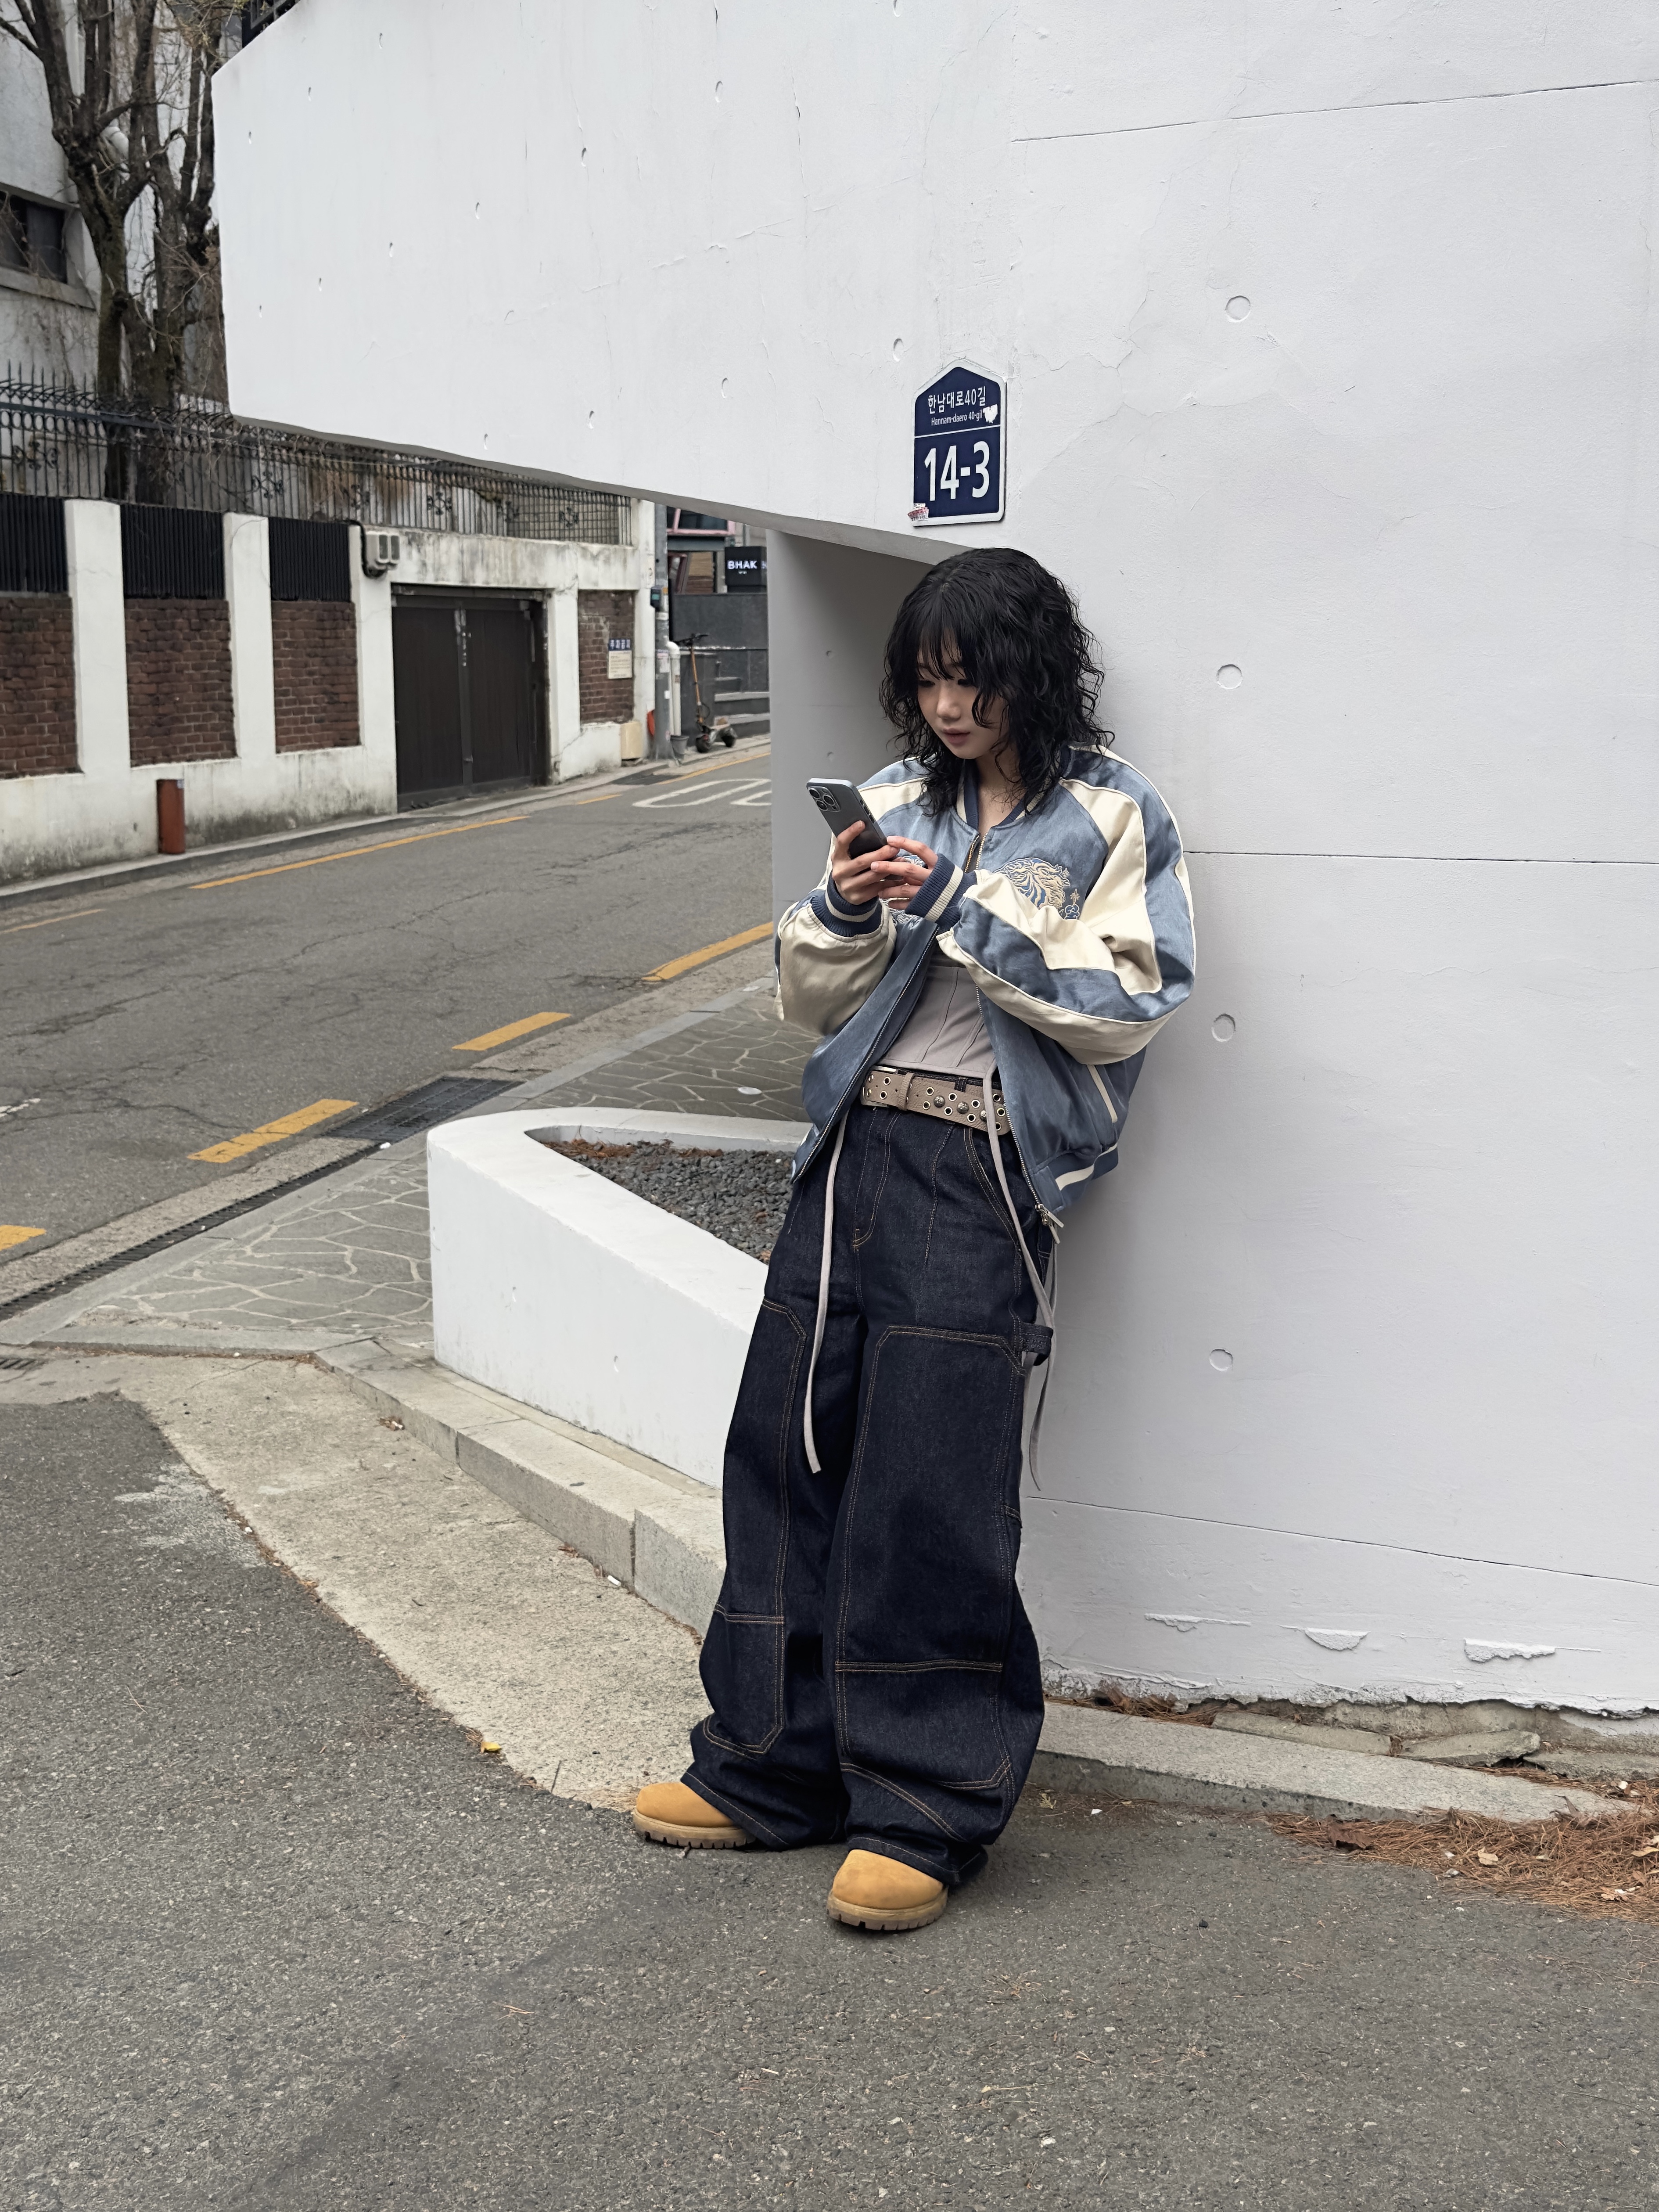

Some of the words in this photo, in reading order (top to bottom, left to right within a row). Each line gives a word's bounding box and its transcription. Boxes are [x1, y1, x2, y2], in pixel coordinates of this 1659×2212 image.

[928, 386, 986, 414] 한남대로40길
[931, 414, 967, 426] Hannam-daero
[968, 409, 983, 422] 40-gil
[924, 441, 990, 501] 14-3
[727, 560, 758, 569] BHAK
